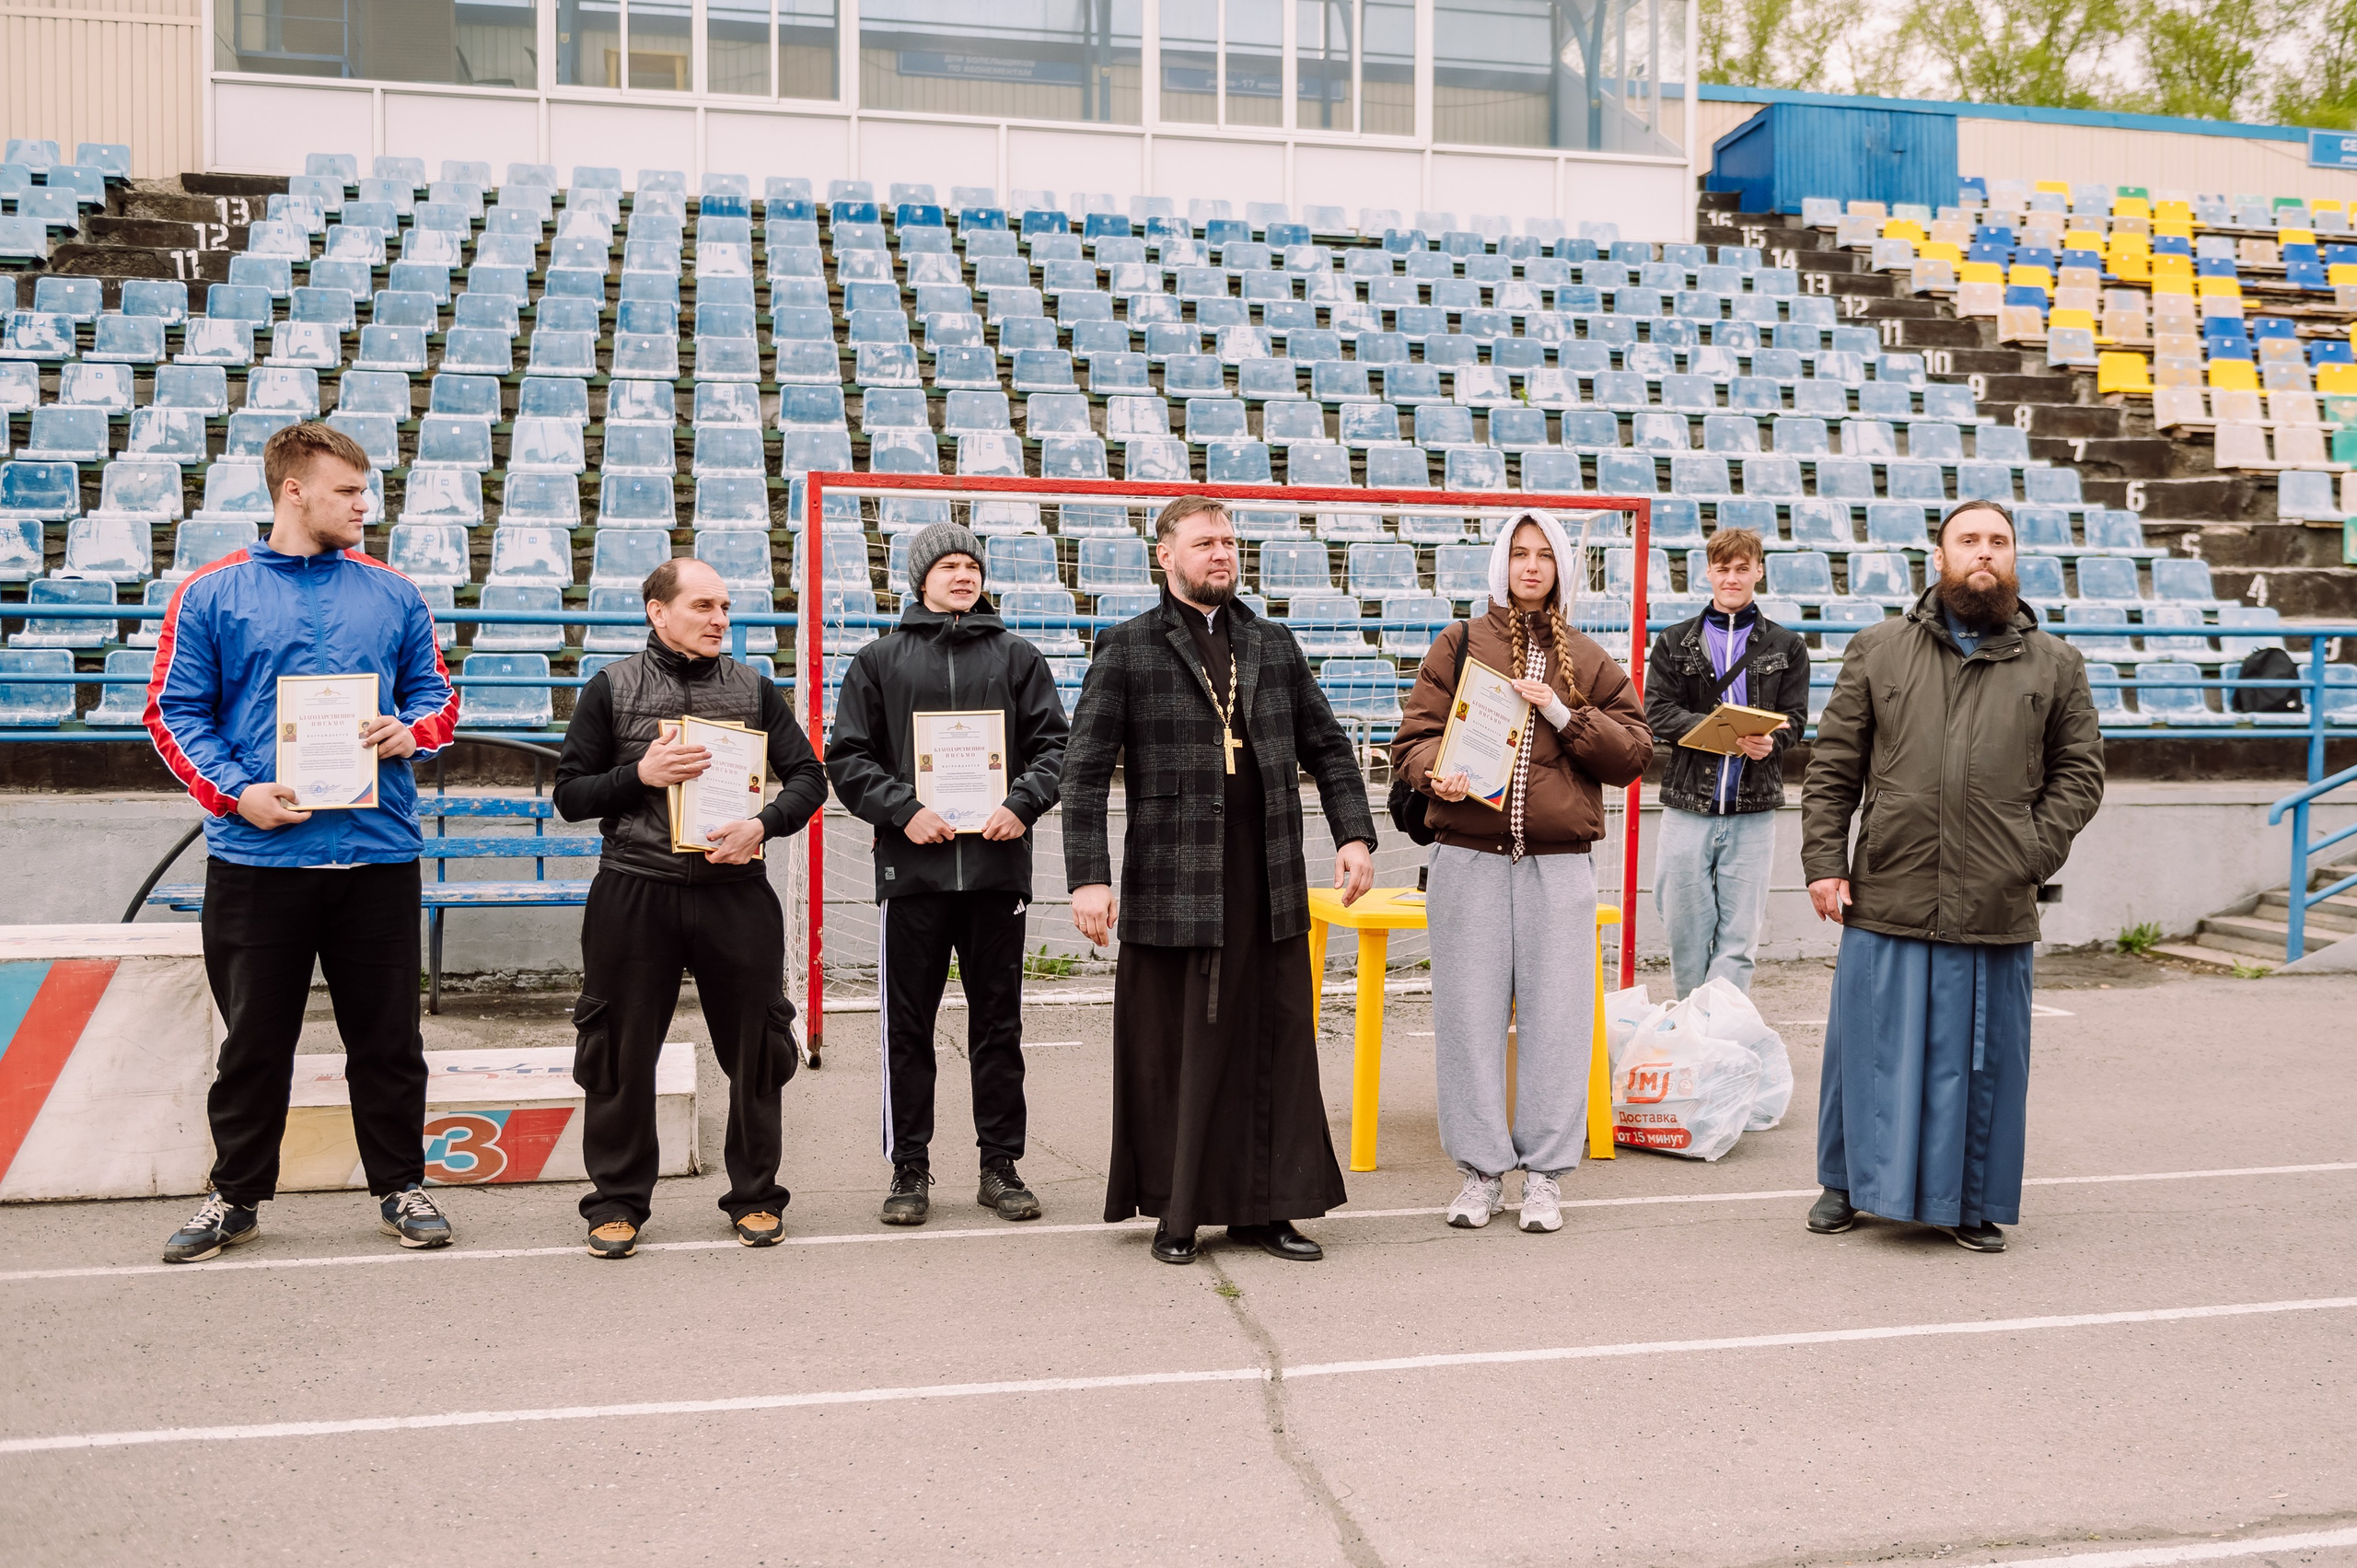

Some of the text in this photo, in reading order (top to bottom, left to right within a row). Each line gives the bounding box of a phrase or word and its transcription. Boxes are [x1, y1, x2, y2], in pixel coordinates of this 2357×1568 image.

[215, 197, 250, 226] 13
[1707, 210, 1733, 227] 16
[193, 223, 229, 250] 12
[1739, 226, 1766, 249] 15
[170, 250, 200, 280] 11
[1771, 247, 1798, 270] 14
[1804, 273, 1830, 295] 13
[1841, 295, 1868, 319] 12
[1879, 319, 1903, 346] 11
[1922, 349, 1952, 375] 10
[1968, 374, 1986, 401] 9
[2014, 404, 2032, 433] 8
[2068, 438, 2086, 462] 7
[2126, 481, 2145, 512] 6
[1619, 1110, 1678, 1123] Доставка
[424, 1114, 507, 1183] 3
[1618, 1132, 1684, 1147] от 15 минут
